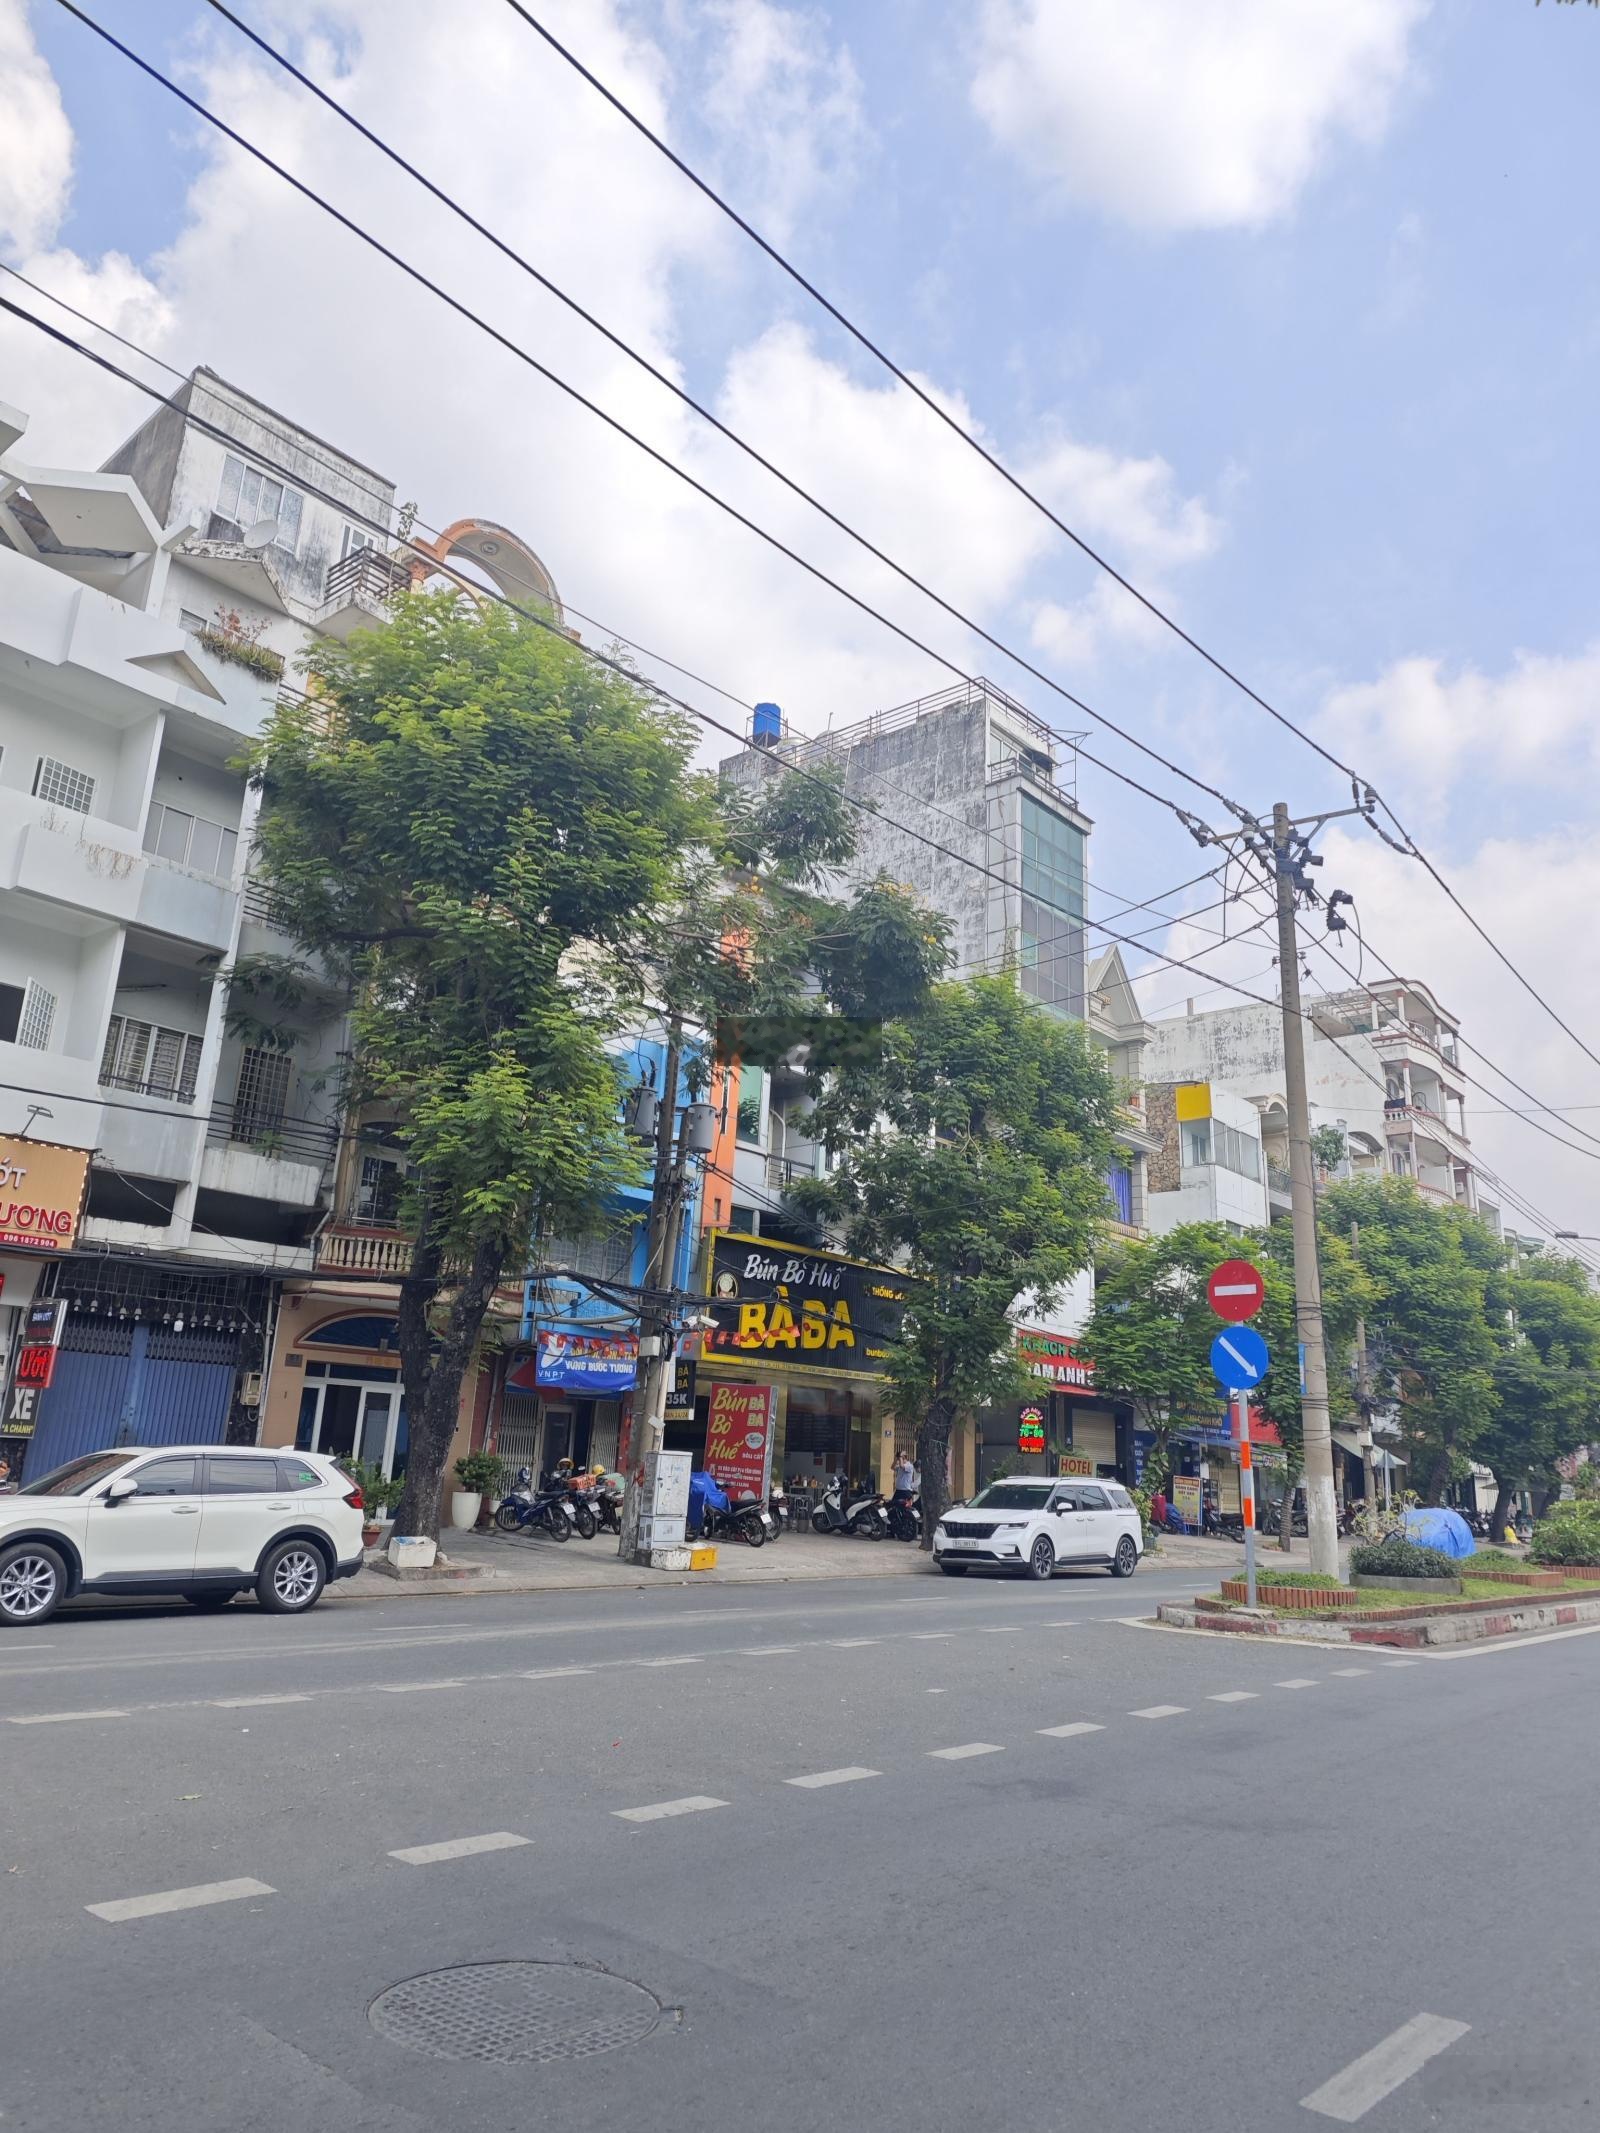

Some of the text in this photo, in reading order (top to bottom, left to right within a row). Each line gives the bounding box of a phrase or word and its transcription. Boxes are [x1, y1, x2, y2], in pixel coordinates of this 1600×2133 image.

[744, 1253, 847, 1291] Bún Bò Huế
[537, 1369, 565, 1379] VNPT
[1057, 1366, 1085, 1384] ANH
[10, 1388, 35, 1420] XE
[667, 1393, 687, 1404] 35K
[713, 1388, 747, 1412] Bún
[710, 1414, 733, 1434] Bò
[747, 1413, 764, 1427] BA
[708, 1439, 744, 1460] Huế
[1061, 1458, 1092, 1475] HOTEL
